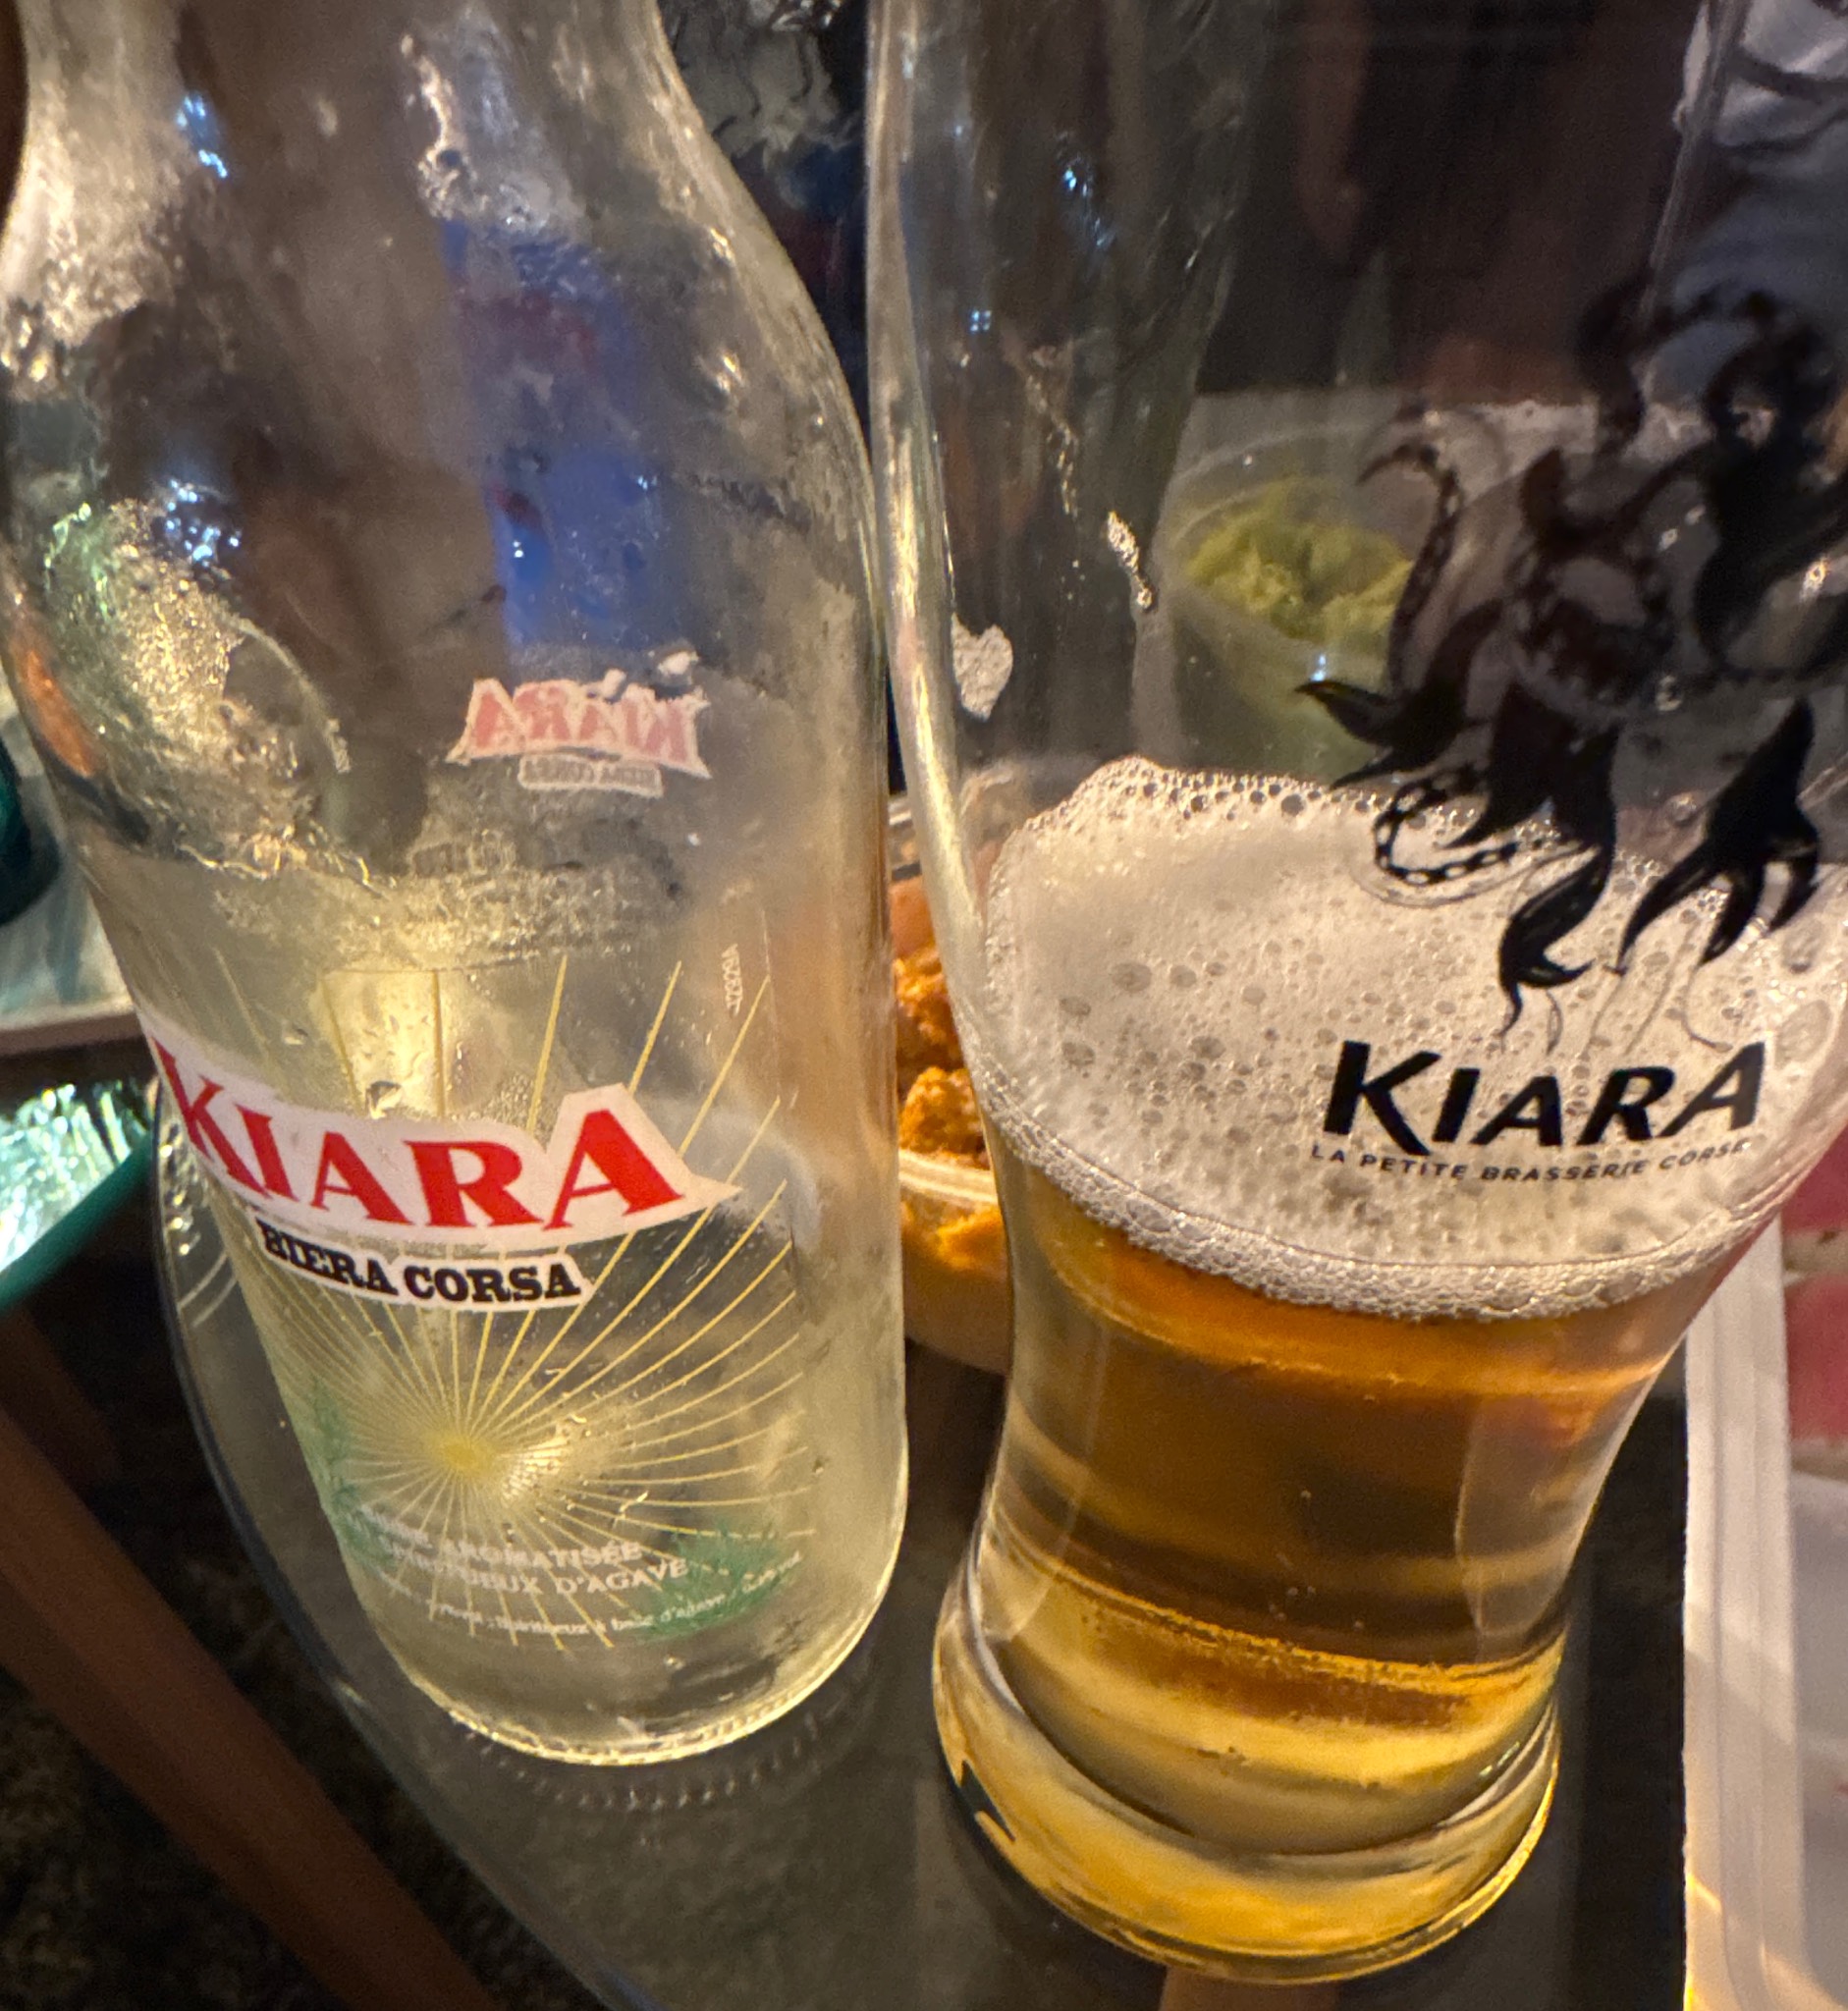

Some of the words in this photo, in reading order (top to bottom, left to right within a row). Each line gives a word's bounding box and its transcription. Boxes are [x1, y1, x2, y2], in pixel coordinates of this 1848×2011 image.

[150, 1036, 684, 1231] KIARA
[1323, 1039, 1765, 1157] KIARA
[1311, 1143, 1345, 1164] LA
[1359, 1153, 1468, 1179] PETITE
[1480, 1158, 1649, 1182] BRASSERIE
[255, 1216, 399, 1296] BIERA
[403, 1264, 581, 1303] CORSA
[555, 1557, 688, 1595] D'AGAVE
